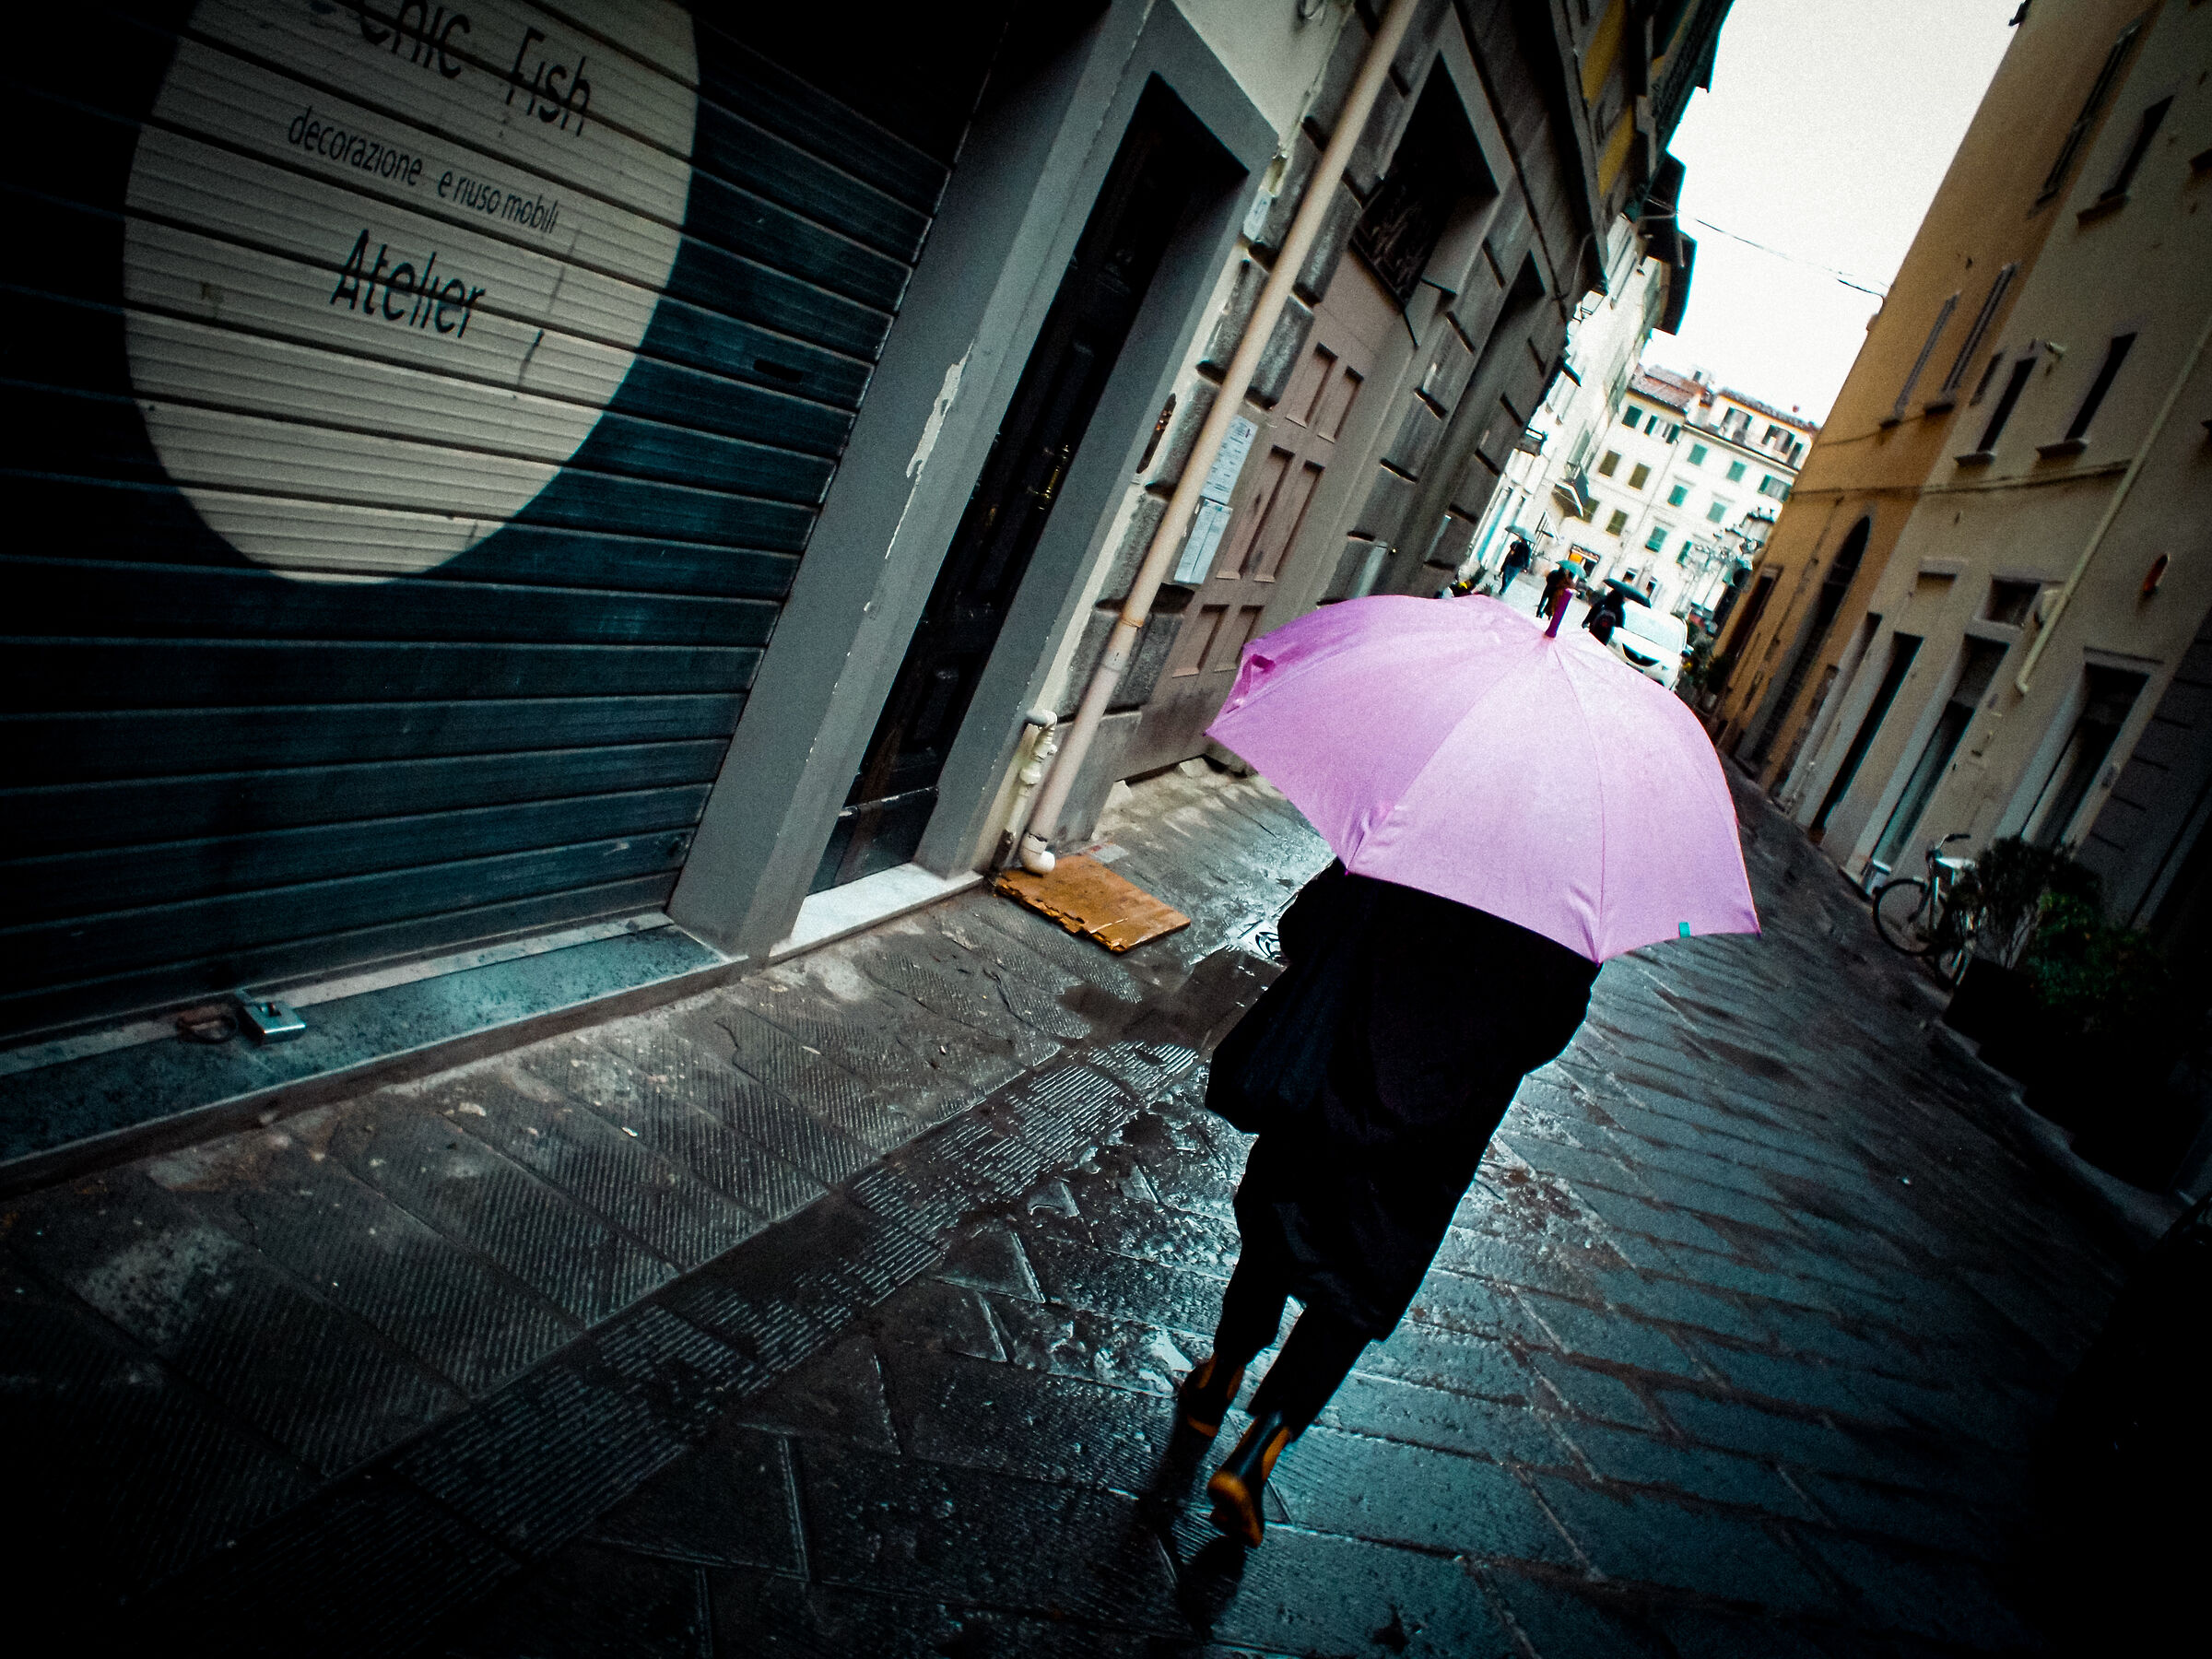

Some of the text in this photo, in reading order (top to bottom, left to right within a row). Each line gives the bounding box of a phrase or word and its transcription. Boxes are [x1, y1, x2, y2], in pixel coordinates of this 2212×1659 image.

[506, 26, 591, 136] Fish
[288, 106, 559, 234] decorazione e riuso mobili
[330, 229, 486, 338] Atelier
